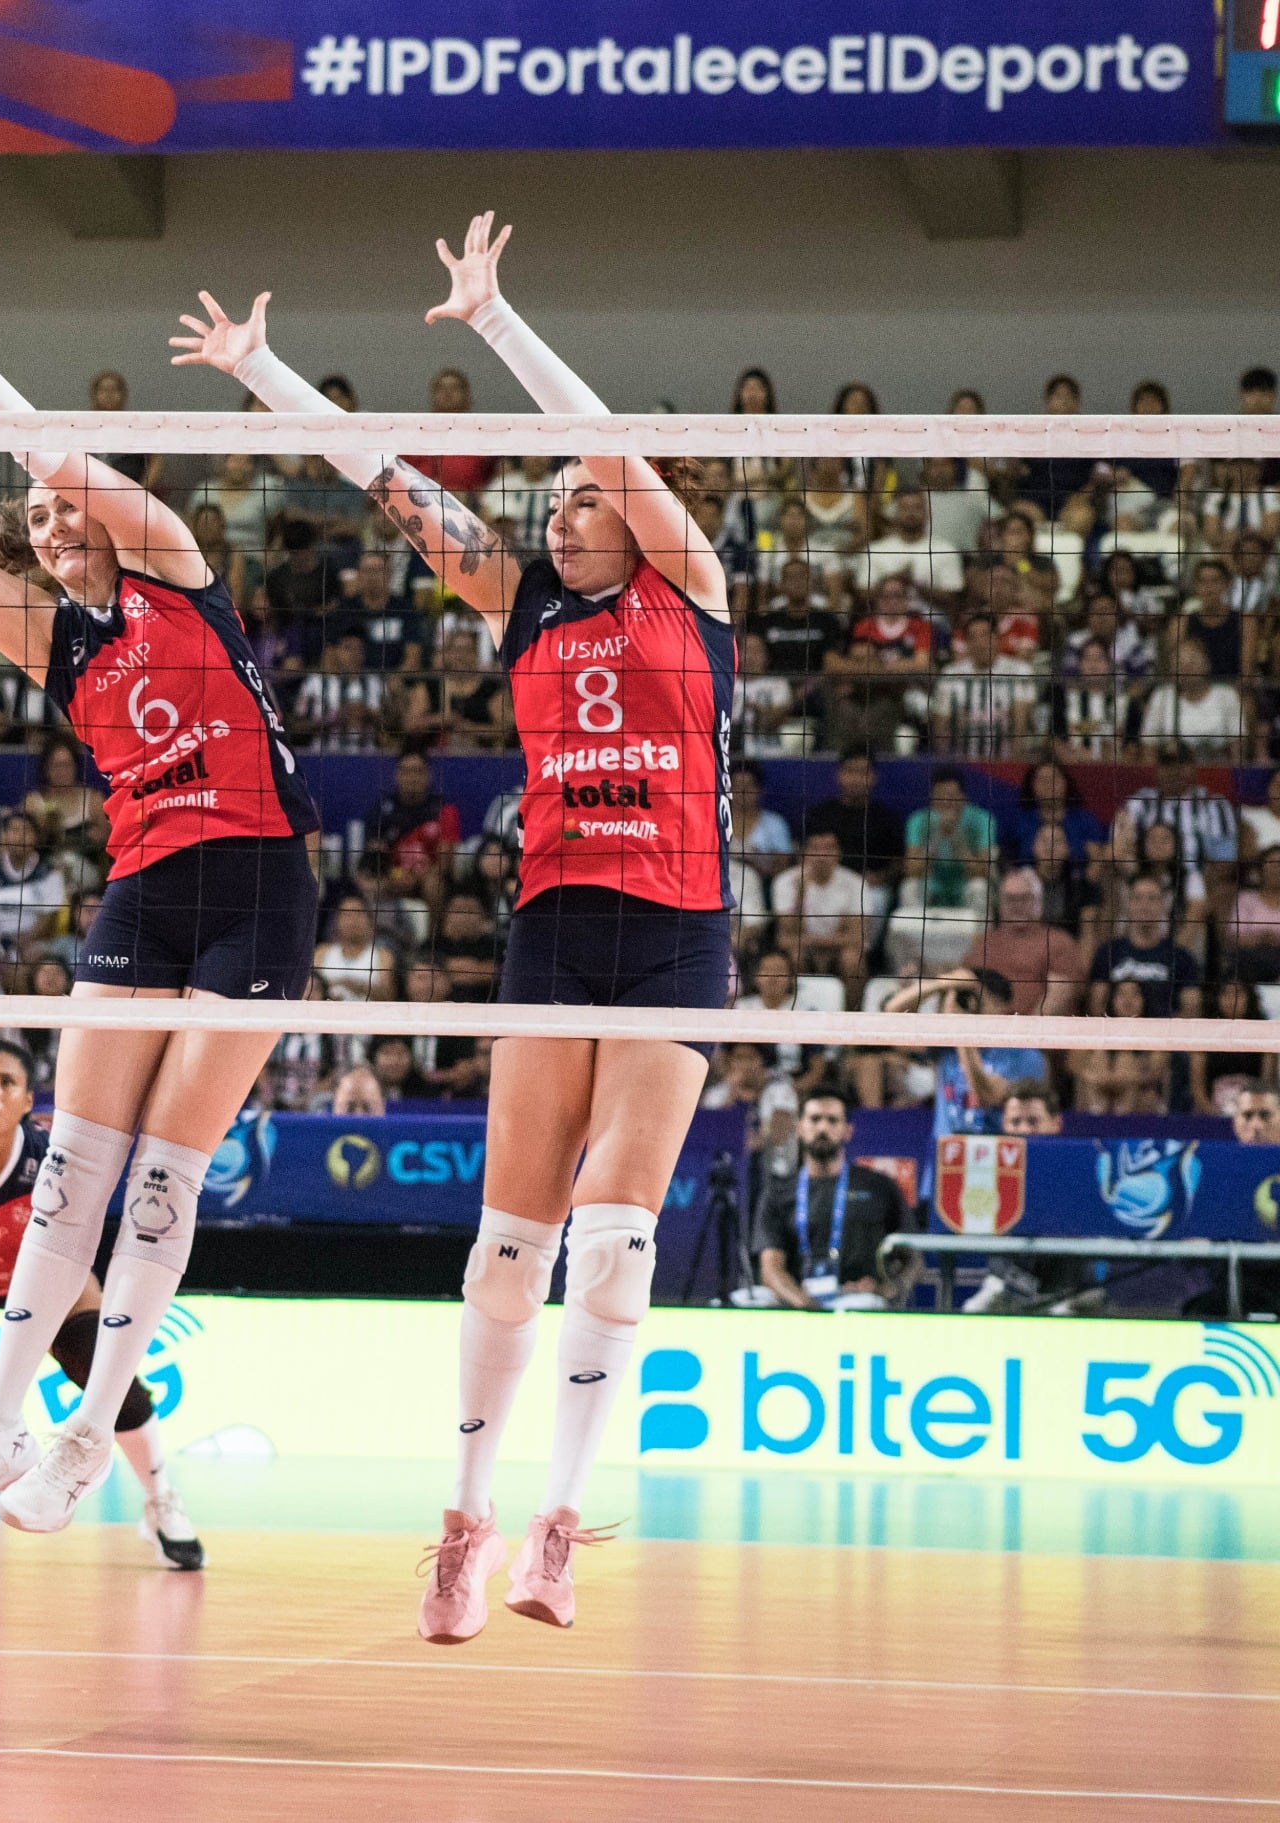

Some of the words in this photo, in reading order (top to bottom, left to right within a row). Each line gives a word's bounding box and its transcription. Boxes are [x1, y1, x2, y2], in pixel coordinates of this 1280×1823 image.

[302, 34, 1189, 111] #IPDFortaleceElDeporte
[557, 635, 630, 660] USMP
[128, 676, 179, 744] 6
[574, 665, 623, 733] 8
[541, 739, 679, 783] apuesta
[562, 778, 652, 809] total
[88, 954, 129, 968] USMP
[387, 1139, 486, 1185] CSV
[743, 1351, 1021, 1460] bitel
[1081, 1361, 1244, 1466] 5G
